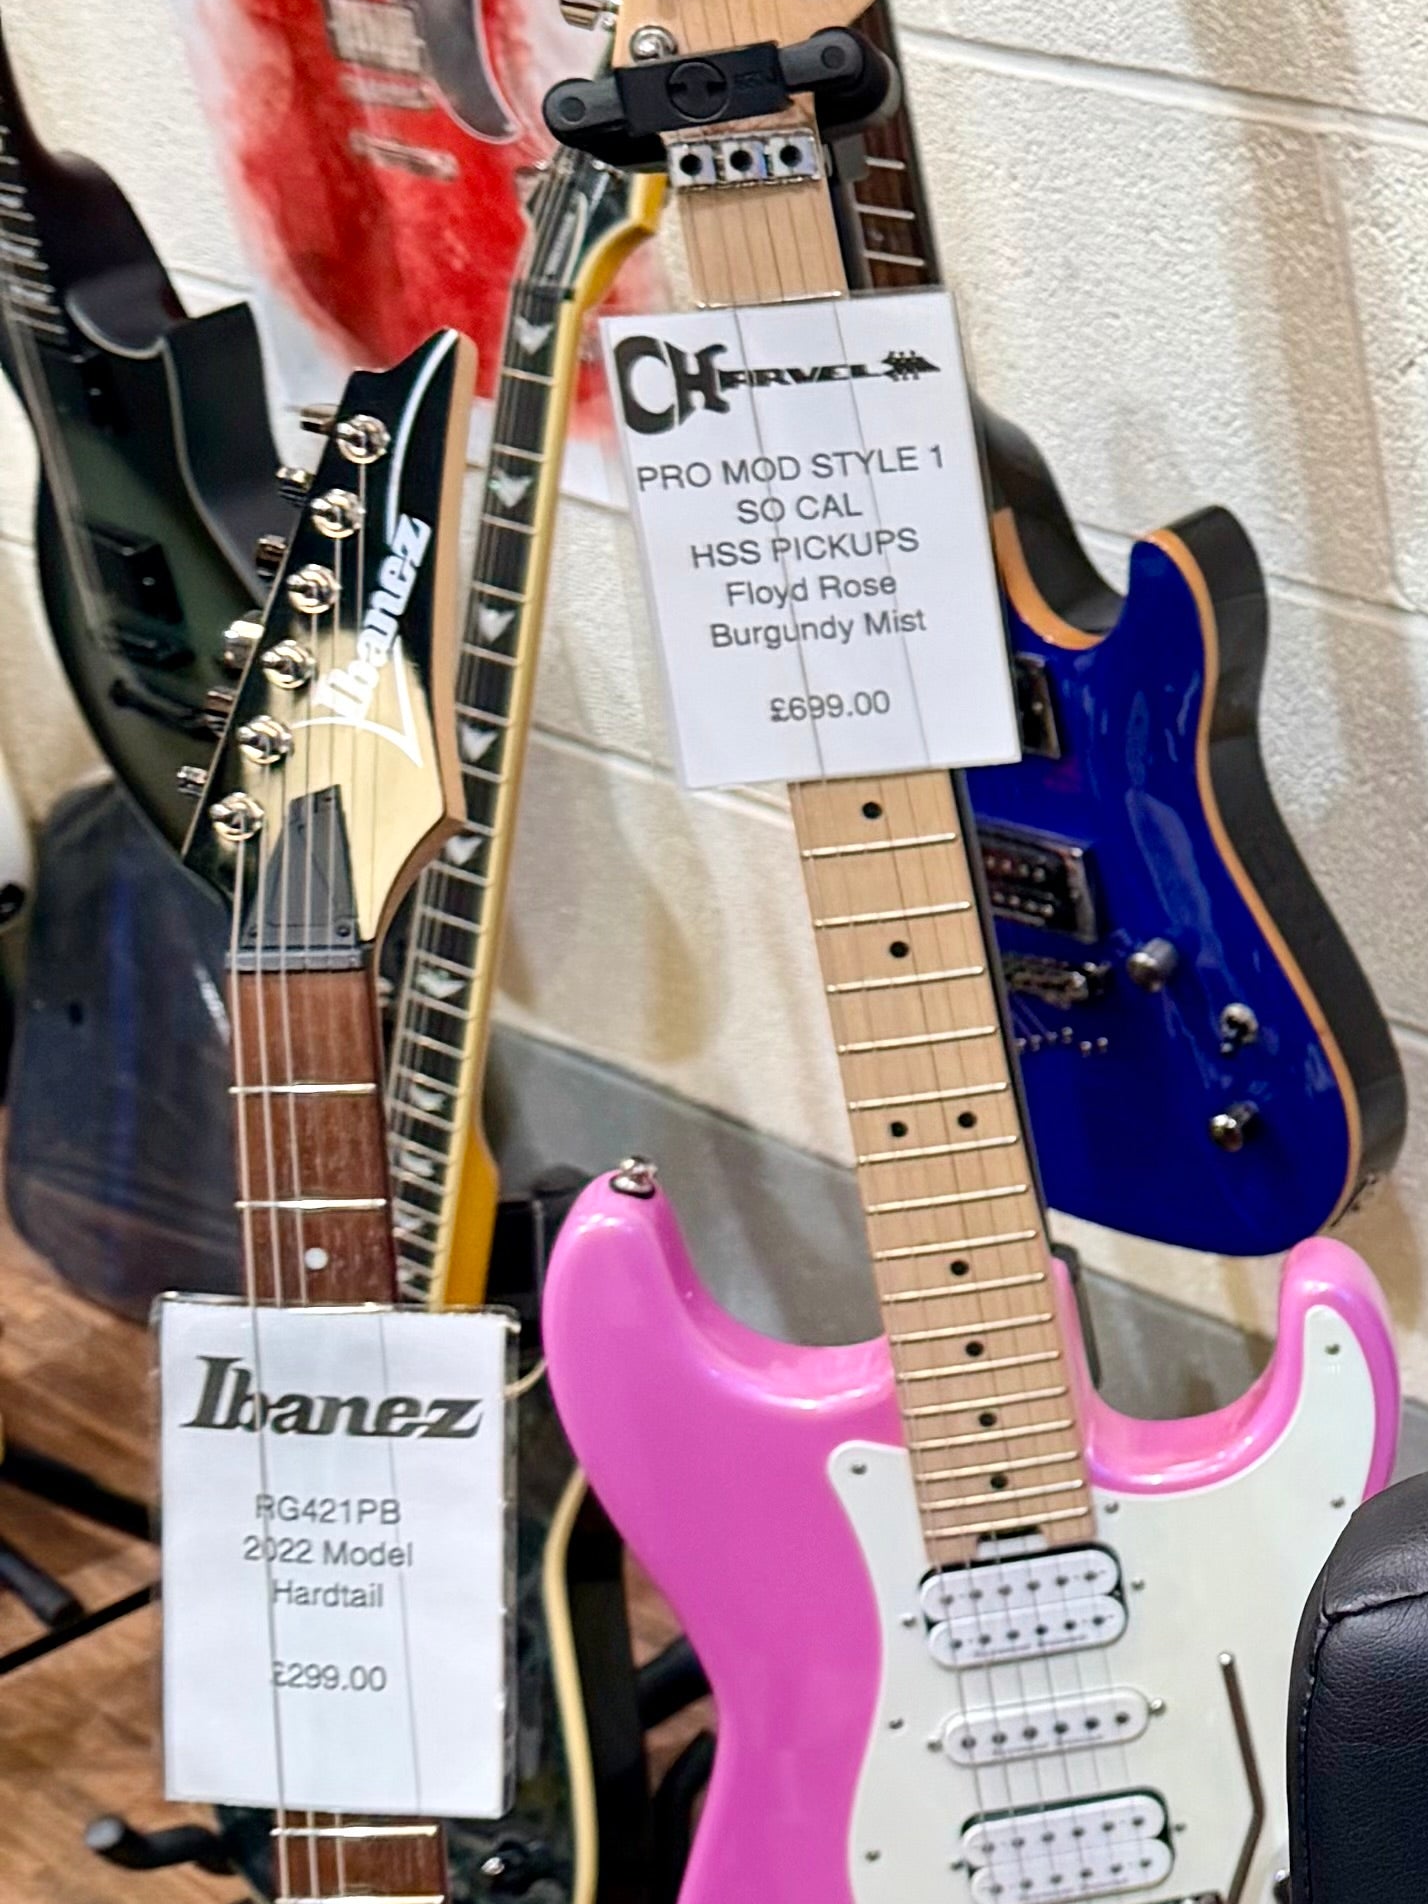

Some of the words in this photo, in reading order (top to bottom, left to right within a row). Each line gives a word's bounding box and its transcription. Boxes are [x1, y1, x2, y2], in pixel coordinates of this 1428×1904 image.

[637, 462, 712, 491] PRO
[722, 455, 801, 485] MOD
[811, 446, 919, 479] STYLE
[930, 444, 944, 469] 1
[736, 497, 786, 524] SO
[795, 493, 863, 521] CAL
[690, 540, 761, 569] HSS
[770, 527, 920, 562] PICKUPS
[725, 577, 809, 609] Floyd
[818, 575, 897, 600] Rose
[312, 513, 432, 722] Ibanez
[709, 615, 854, 650] Burgundy
[863, 609, 927, 636] Mist
[769, 690, 891, 722] £699.00
[178, 1354, 485, 1440] Ibanez
[255, 1493, 401, 1525] RG421PB
[243, 1534, 314, 1565] 2022
[323, 1539, 413, 1567] Model
[271, 1578, 384, 1608] Hardtail
[271, 1660, 387, 1692] £299.00
